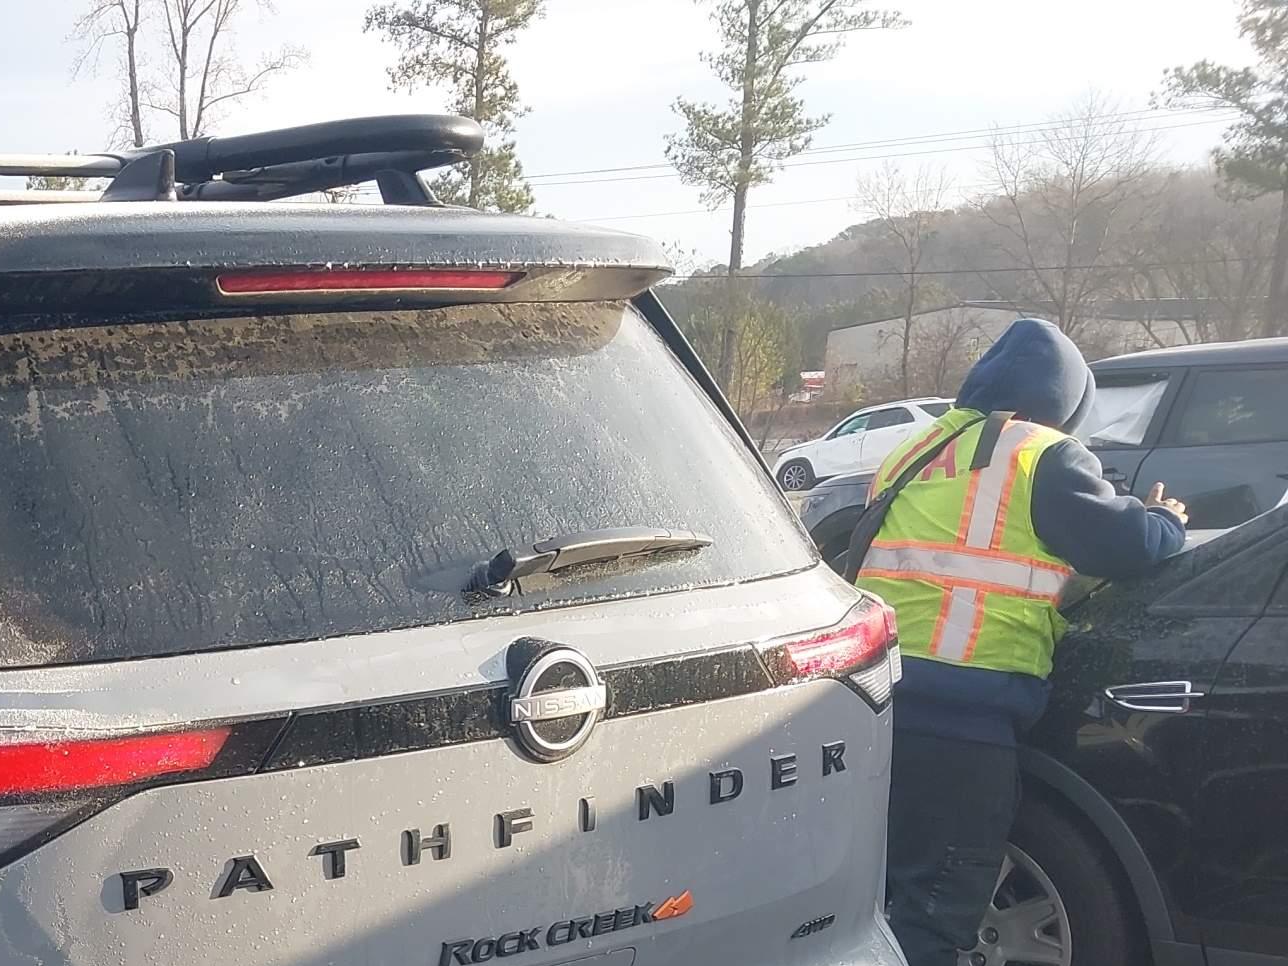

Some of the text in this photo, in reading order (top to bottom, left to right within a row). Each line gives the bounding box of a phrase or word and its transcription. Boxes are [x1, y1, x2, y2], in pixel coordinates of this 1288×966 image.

[884, 427, 958, 482] IA
[514, 692, 602, 718] NISSAN
[121, 739, 848, 911] PATHFINDER
[546, 901, 655, 947] CREEK
